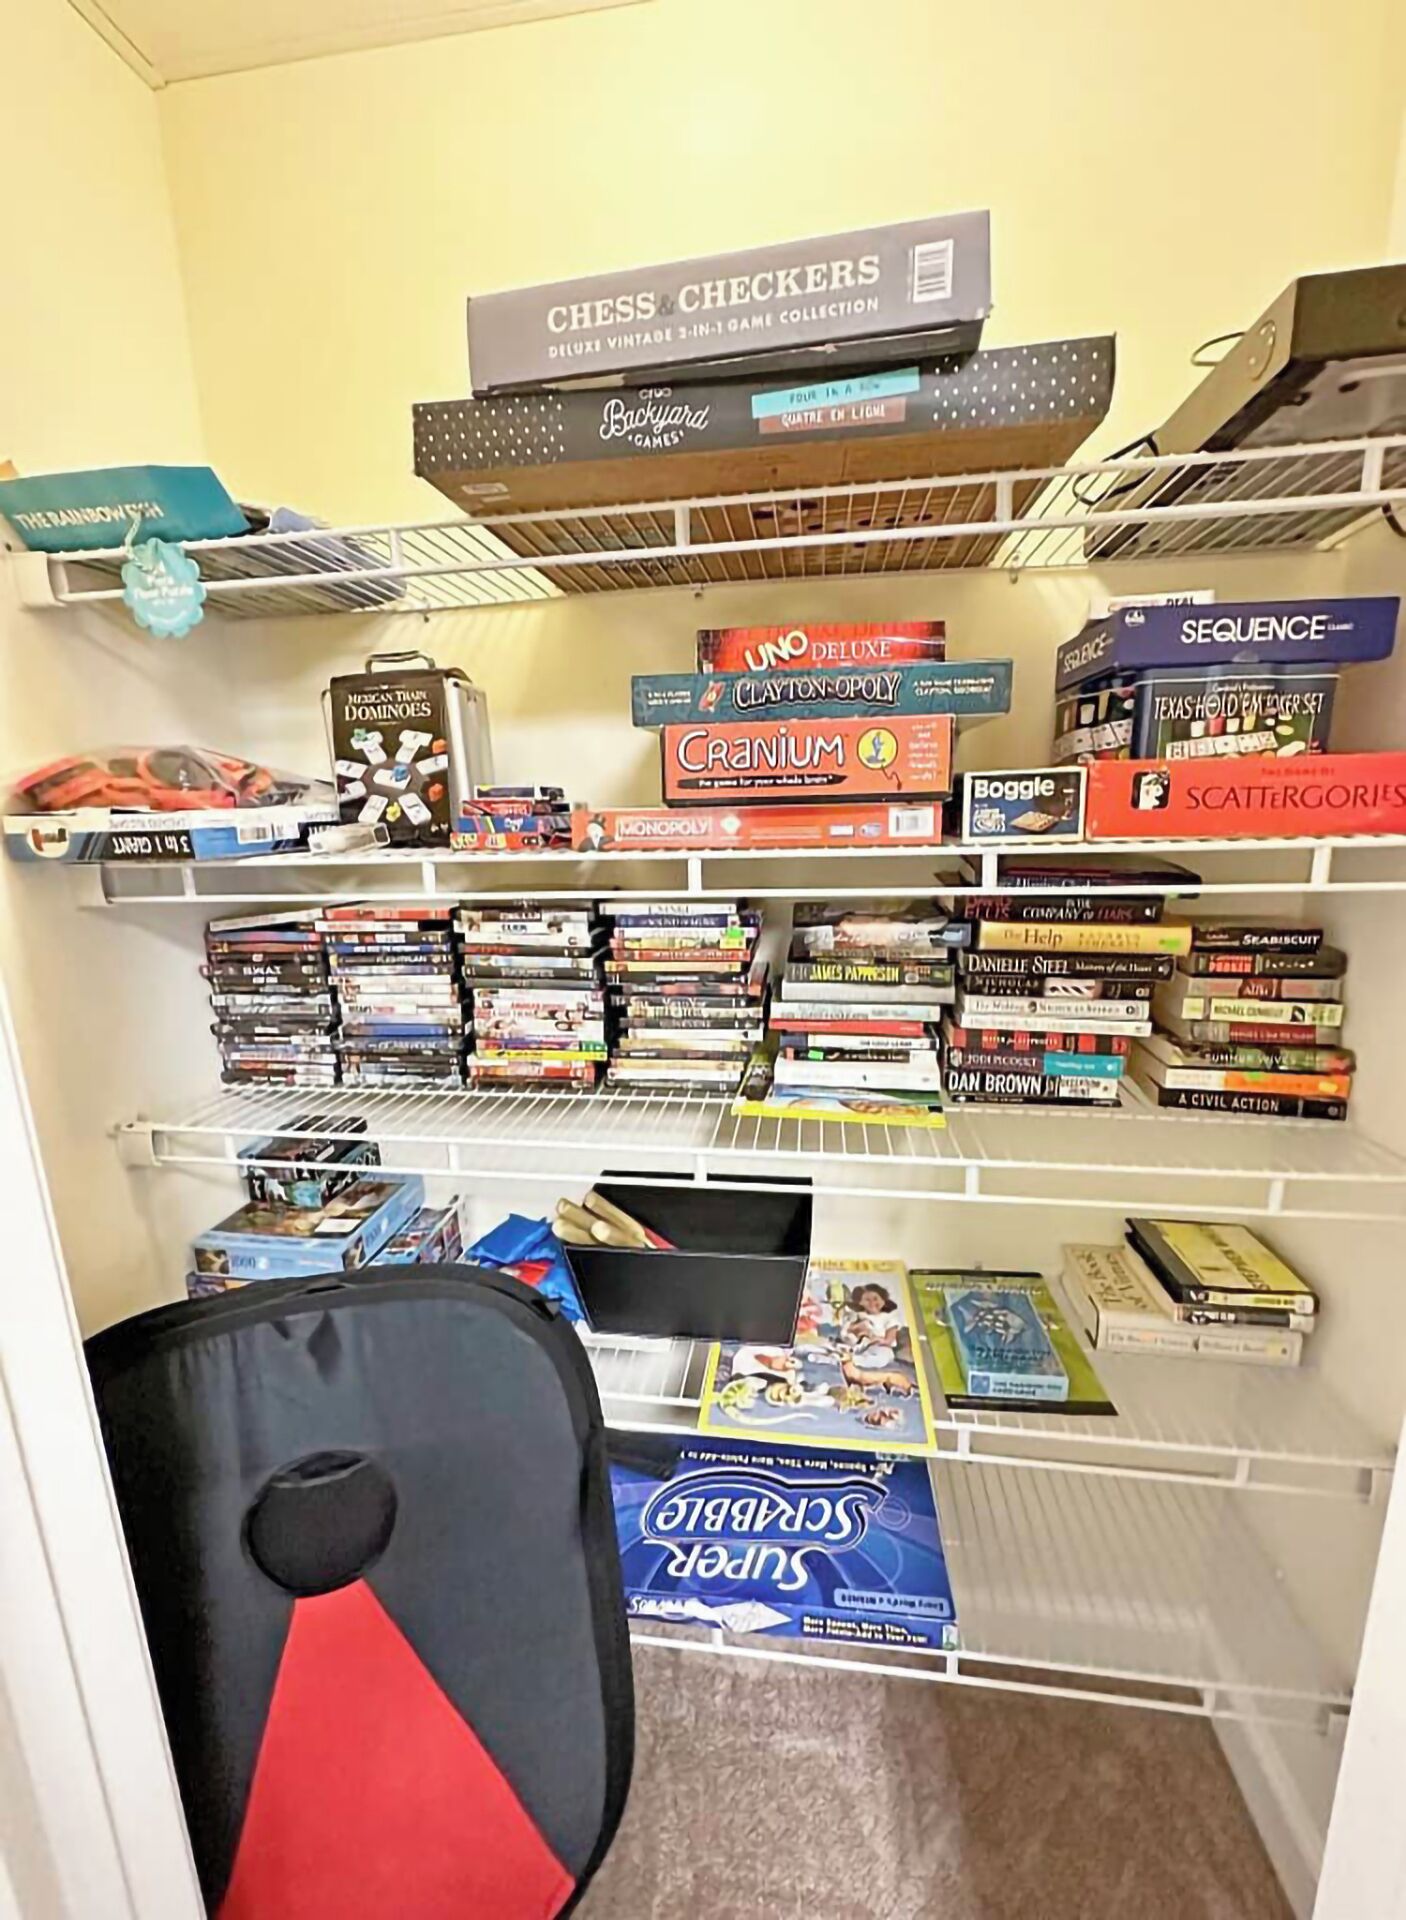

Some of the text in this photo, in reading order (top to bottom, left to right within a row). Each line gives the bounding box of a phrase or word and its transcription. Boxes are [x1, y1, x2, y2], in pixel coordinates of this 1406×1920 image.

[547, 254, 880, 333] CHESS & CHECKERS
[548, 338, 600, 359] DELUXE
[607, 327, 673, 349] VINTAGE
[728, 313, 772, 333] GAME
[780, 297, 879, 324] COLLECTION
[826, 386, 839, 398] IN
[845, 383, 852, 394] A
[600, 398, 710, 440] Backyard
[781, 411, 823, 428] QUATRE
[831, 408, 844, 422] EN
[634, 430, 680, 448] GAMES
[15, 511, 52, 530] THE
[50, 504, 127, 528] RAINBOW
[1181, 615, 1329, 643] SEQUENCE
[744, 630, 892, 672] UNO DELUXE
[348, 690, 429, 705] MEXICAN TRAIN
[1154, 696, 1192, 720] TEXAS
[1195, 692, 1238, 719] HOLD
[1302, 692, 1325, 715] SET
[344, 702, 432, 721] DOMINOES
[974, 776, 1055, 801] Boggle
[1186, 785, 1406, 810] SCATTERGORIES
[618, 817, 710, 838] MONOPOLY
[112, 836, 152, 853] GIANT
[1023, 907, 1083, 920] COMPANY
[1024, 928, 1063, 948] Help
[1242, 934, 1320, 946] SEABISCUIT
[810, 964, 842, 981] JAMES
[845, 965, 900, 983] PATTERSON
[968, 953, 1028, 973] DANIELLE
[1032, 955, 1071, 975] STEEL
[948, 1071, 1042, 1095] DAN BROWN
[1178, 1093, 1280, 1112] A CIVIL ACTION
[655, 1486, 868, 1541] SCRABBLE
[643, 1539, 826, 1592] SUPER
